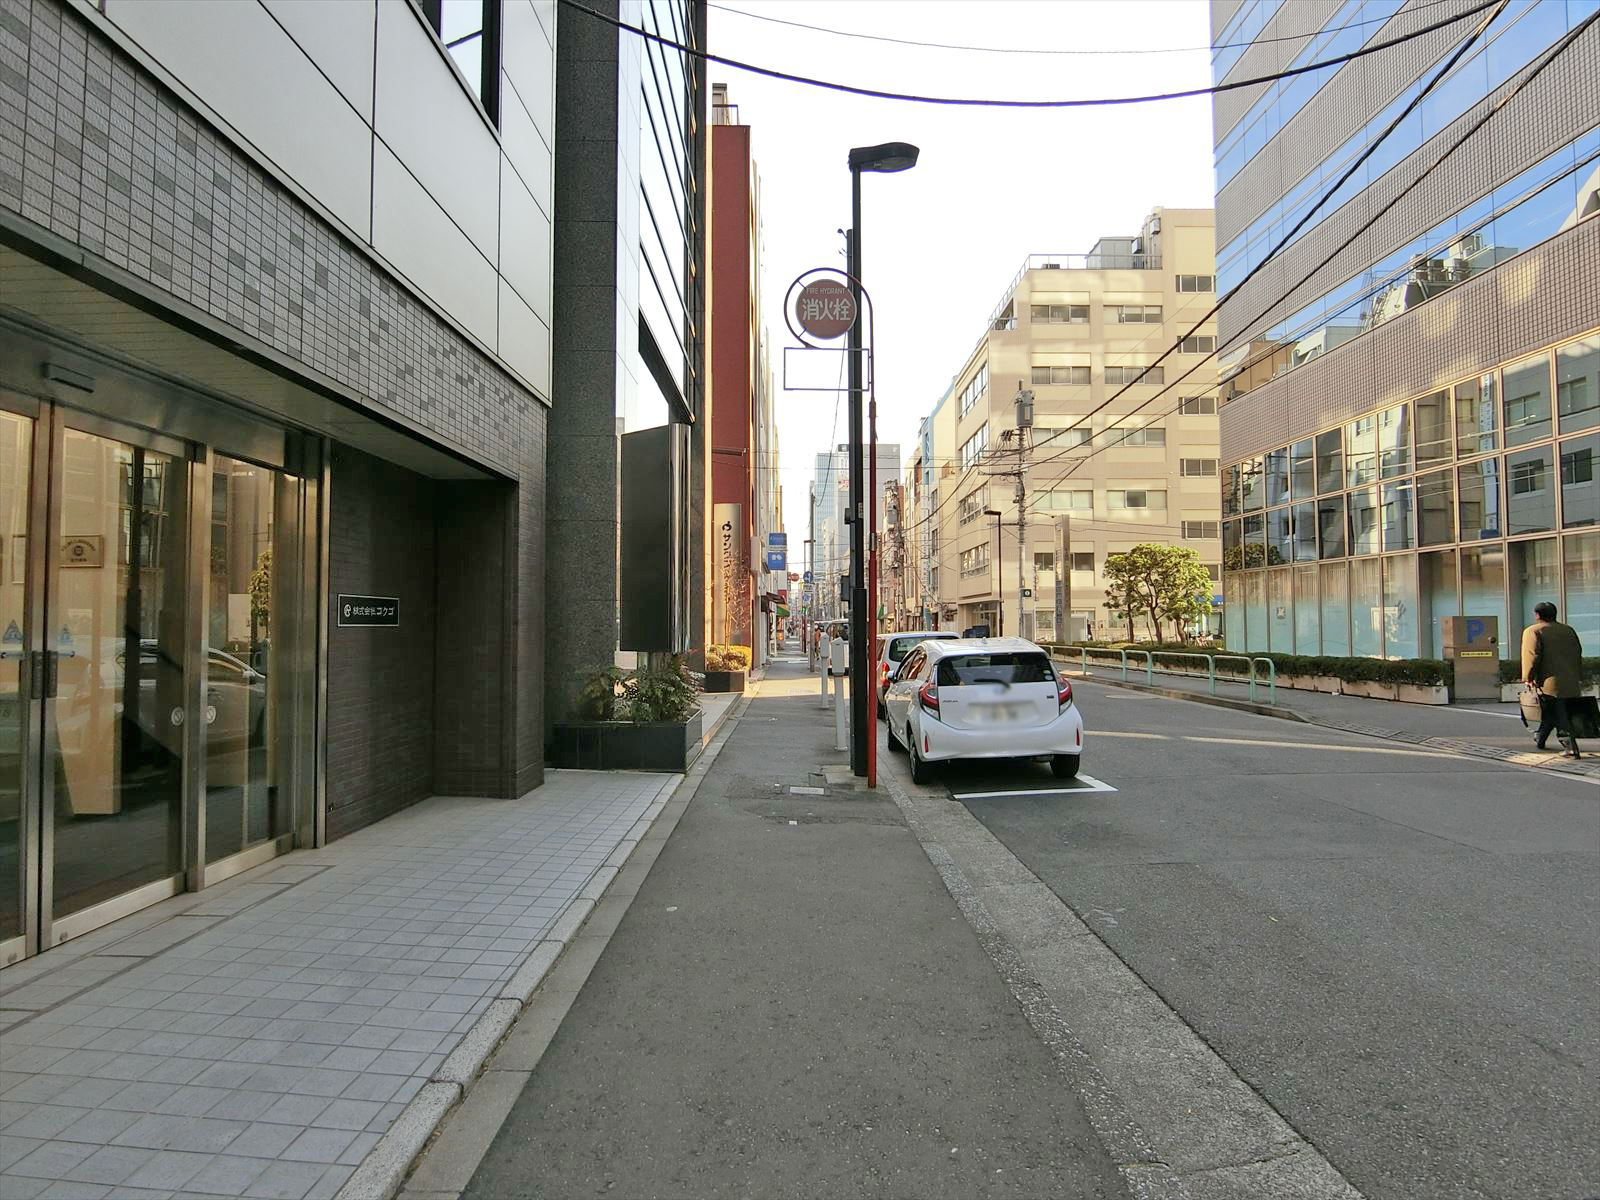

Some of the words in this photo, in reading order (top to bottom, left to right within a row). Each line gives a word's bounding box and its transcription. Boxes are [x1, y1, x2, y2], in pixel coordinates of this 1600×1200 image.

[806, 287, 818, 295] FIRE
[819, 287, 845, 295] HYDRANT
[802, 298, 851, 321] 消火栓
[1467, 620, 1484, 643] P
